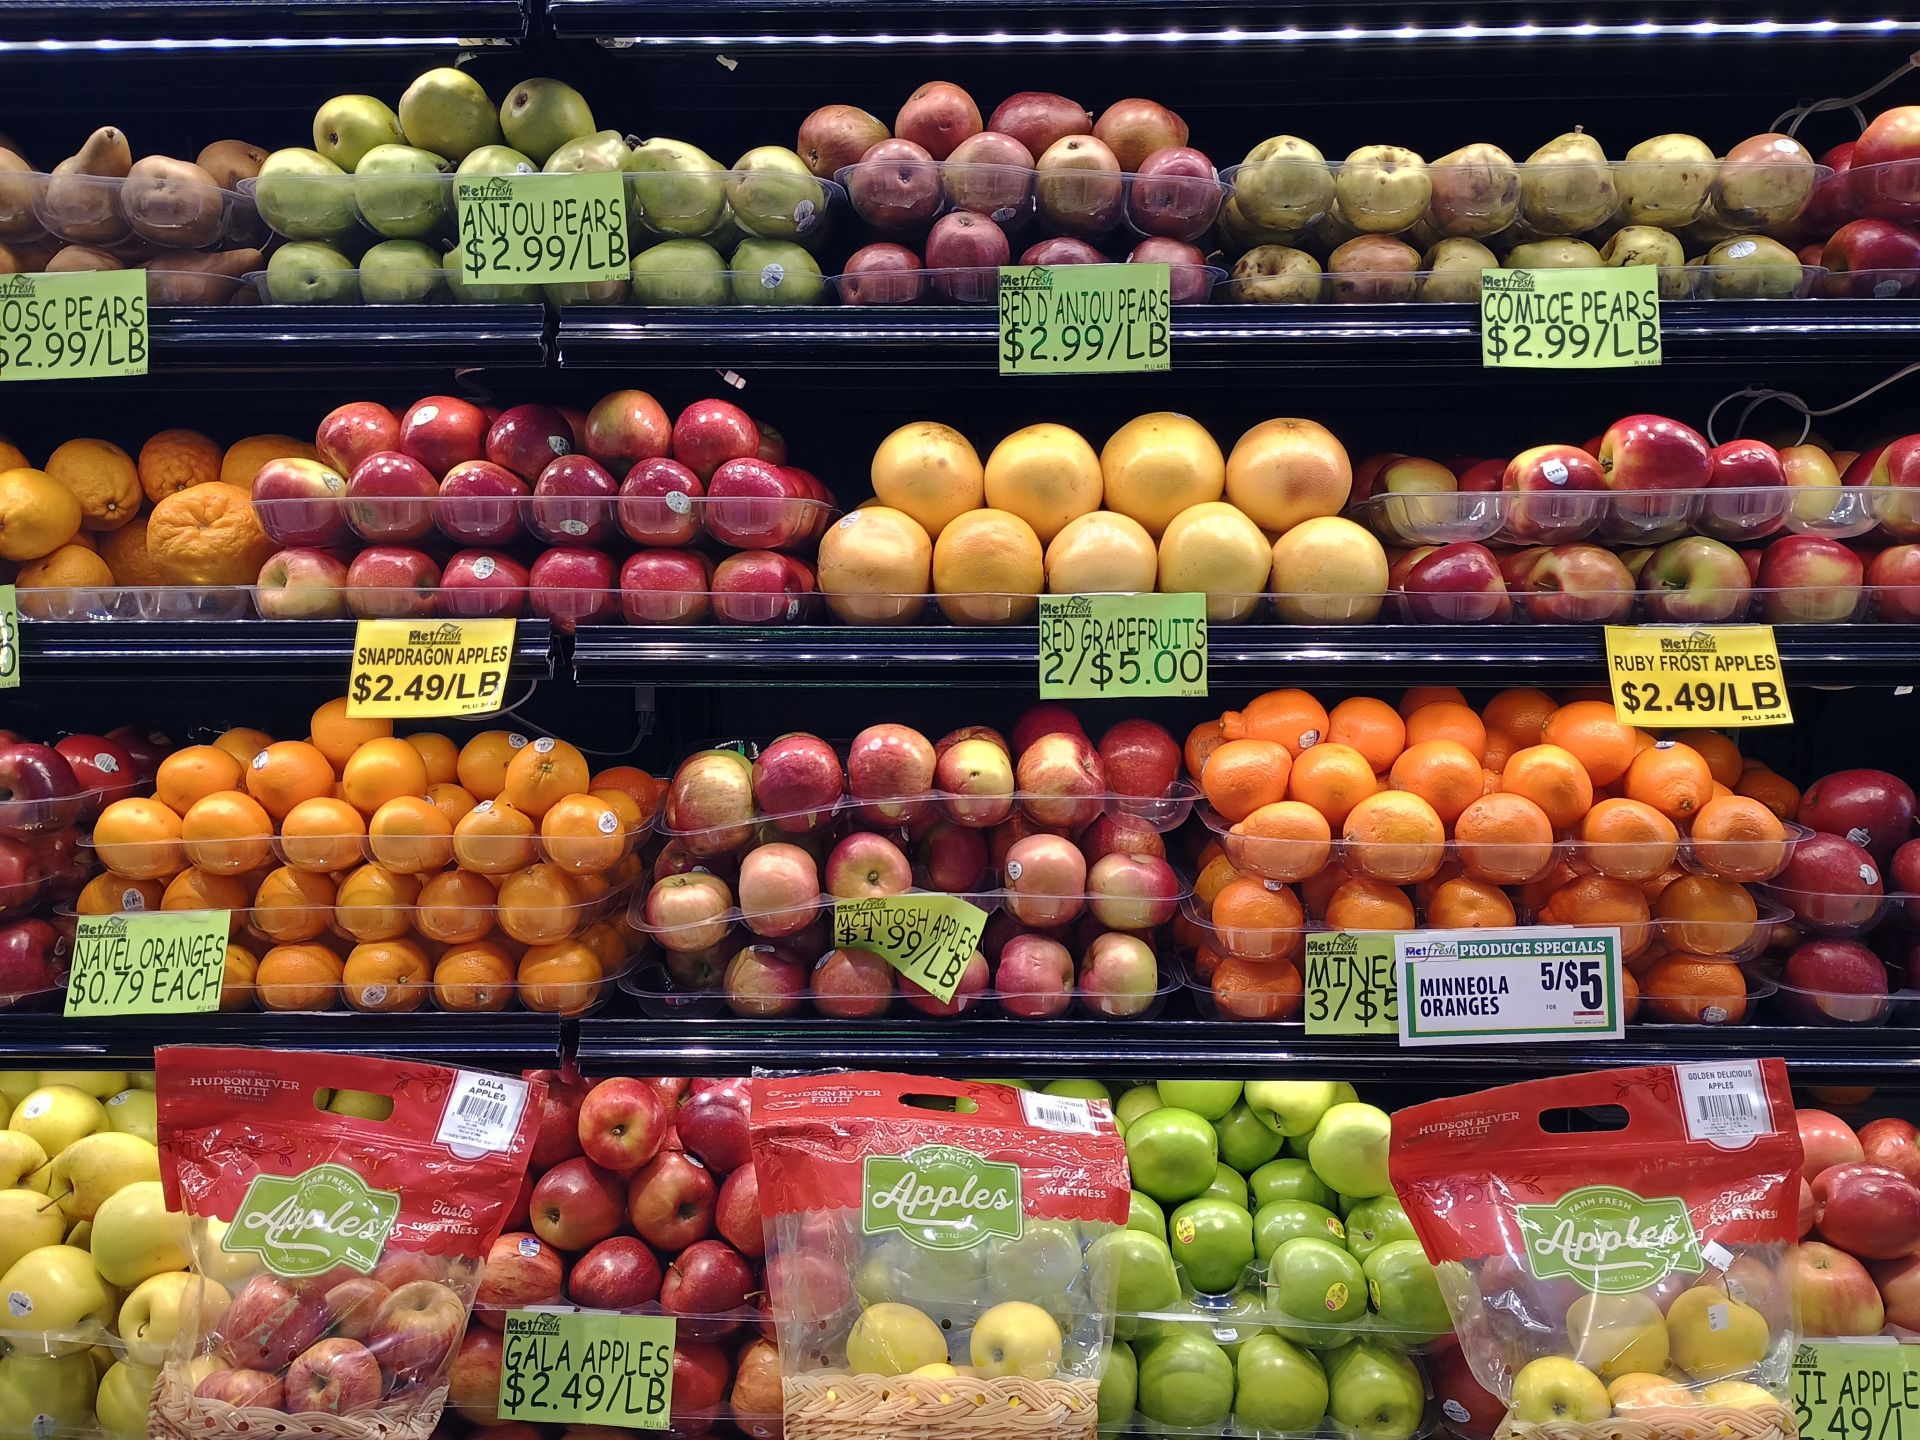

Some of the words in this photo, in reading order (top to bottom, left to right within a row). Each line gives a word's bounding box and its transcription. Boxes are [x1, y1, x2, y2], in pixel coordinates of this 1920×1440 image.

[459, 177, 514, 204] Metfresh
[462, 201, 544, 238] ANJOU
[553, 199, 622, 236] PEARS
[465, 232, 627, 279] $2.99/LB
[0, 275, 36, 301] tfresh
[1000, 267, 1054, 293] Metfresh
[1482, 270, 1536, 296] Metfresh
[0, 299, 56, 333] OSC
[65, 296, 145, 331] PEARS
[1001, 291, 1032, 326] RED
[1119, 288, 1169, 324] PEARS
[1484, 291, 1573, 325] COMICE
[1581, 290, 1657, 325] PEARS
[1003, 321, 1168, 369] $2.99/LB
[1487, 320, 1659, 363] $2.99/LB
[1040, 595, 1093, 620] Metfresh
[409, 623, 463, 648] Metfresh
[1041, 619, 1074, 652] RED
[1081, 617, 1205, 651] GRAPEFRUITS
[1660, 631, 1717, 656] Metfresh
[357, 647, 453, 665] SNAPDRAGON
[456, 645, 508, 664] APPLES
[1044, 644, 1203, 691] 2/$5.00
[1614, 655, 1655, 671] RUBY
[1660, 655, 1710, 672] FROST
[1714, 654, 1776, 671] APPLES
[352, 671, 501, 704] $2.49/LB
[1621, 680, 1781, 714] $2.49/LB
[1764, 712, 1787, 720] 3443
[837, 908, 930, 934] MCINTOSH
[929, 913, 978, 962] APPLES
[1307, 933, 1359, 958] Metfresh
[73, 938, 133, 971] NAVEL
[140, 934, 225, 969] ORANGES
[838, 921, 962, 988] $1.99/LB
[1405, 942, 1457, 962] Metfresh
[1459, 942, 1532, 957] PRODUCE
[1534, 940, 1606, 956] SPECIALS
[69, 968, 144, 1012] $0.79
[152, 965, 222, 1003] EACH
[1420, 975, 1510, 997] MINNEOLA
[1540, 960, 1603, 1010] 5/$5
[1420, 996, 1500, 1017] ORANGES
[190, 1077, 251, 1087] HUDSON
[254, 1078, 300, 1091] RIVER
[477, 1079, 504, 1091] GALA
[1688, 1071, 1715, 1080] GOLDEN
[1717, 1069, 1753, 1079] DELICIOUS
[1708, 1081, 1734, 1090] APPLES
[223, 1085, 269, 1097] FRUIT
[468, 1086, 507, 1102] APPLES
[783, 1089, 836, 1098] HUDSON
[1418, 1118, 1473, 1135] HUDSON
[1476, 1111, 1521, 1126] RIVER
[1447, 1124, 1491, 1138] FRUIT
[300, 1173, 325, 1189] FARM
[326, 1175, 356, 1194] FRESH
[1052, 1165, 1092, 1181] Taste
[872, 1171, 1014, 1232] Apples
[1038, 1186, 1107, 1199] SWEETNESS
[1568, 1197, 1596, 1214] FARM
[1599, 1197, 1632, 1211] FRESH
[1720, 1188, 1767, 1205] Taste
[431, 1199, 473, 1219] Taste
[244, 1195, 385, 1258] Apples
[411, 1221, 480, 1235] SWEETNESS
[1535, 1215, 1685, 1271] Apples
[506, 1312, 561, 1338] Metfresh
[505, 1335, 571, 1372] GALA
[581, 1340, 670, 1378] APPLES
[503, 1366, 666, 1415] $2.49/LB
[1792, 1370, 1828, 1407] JI
